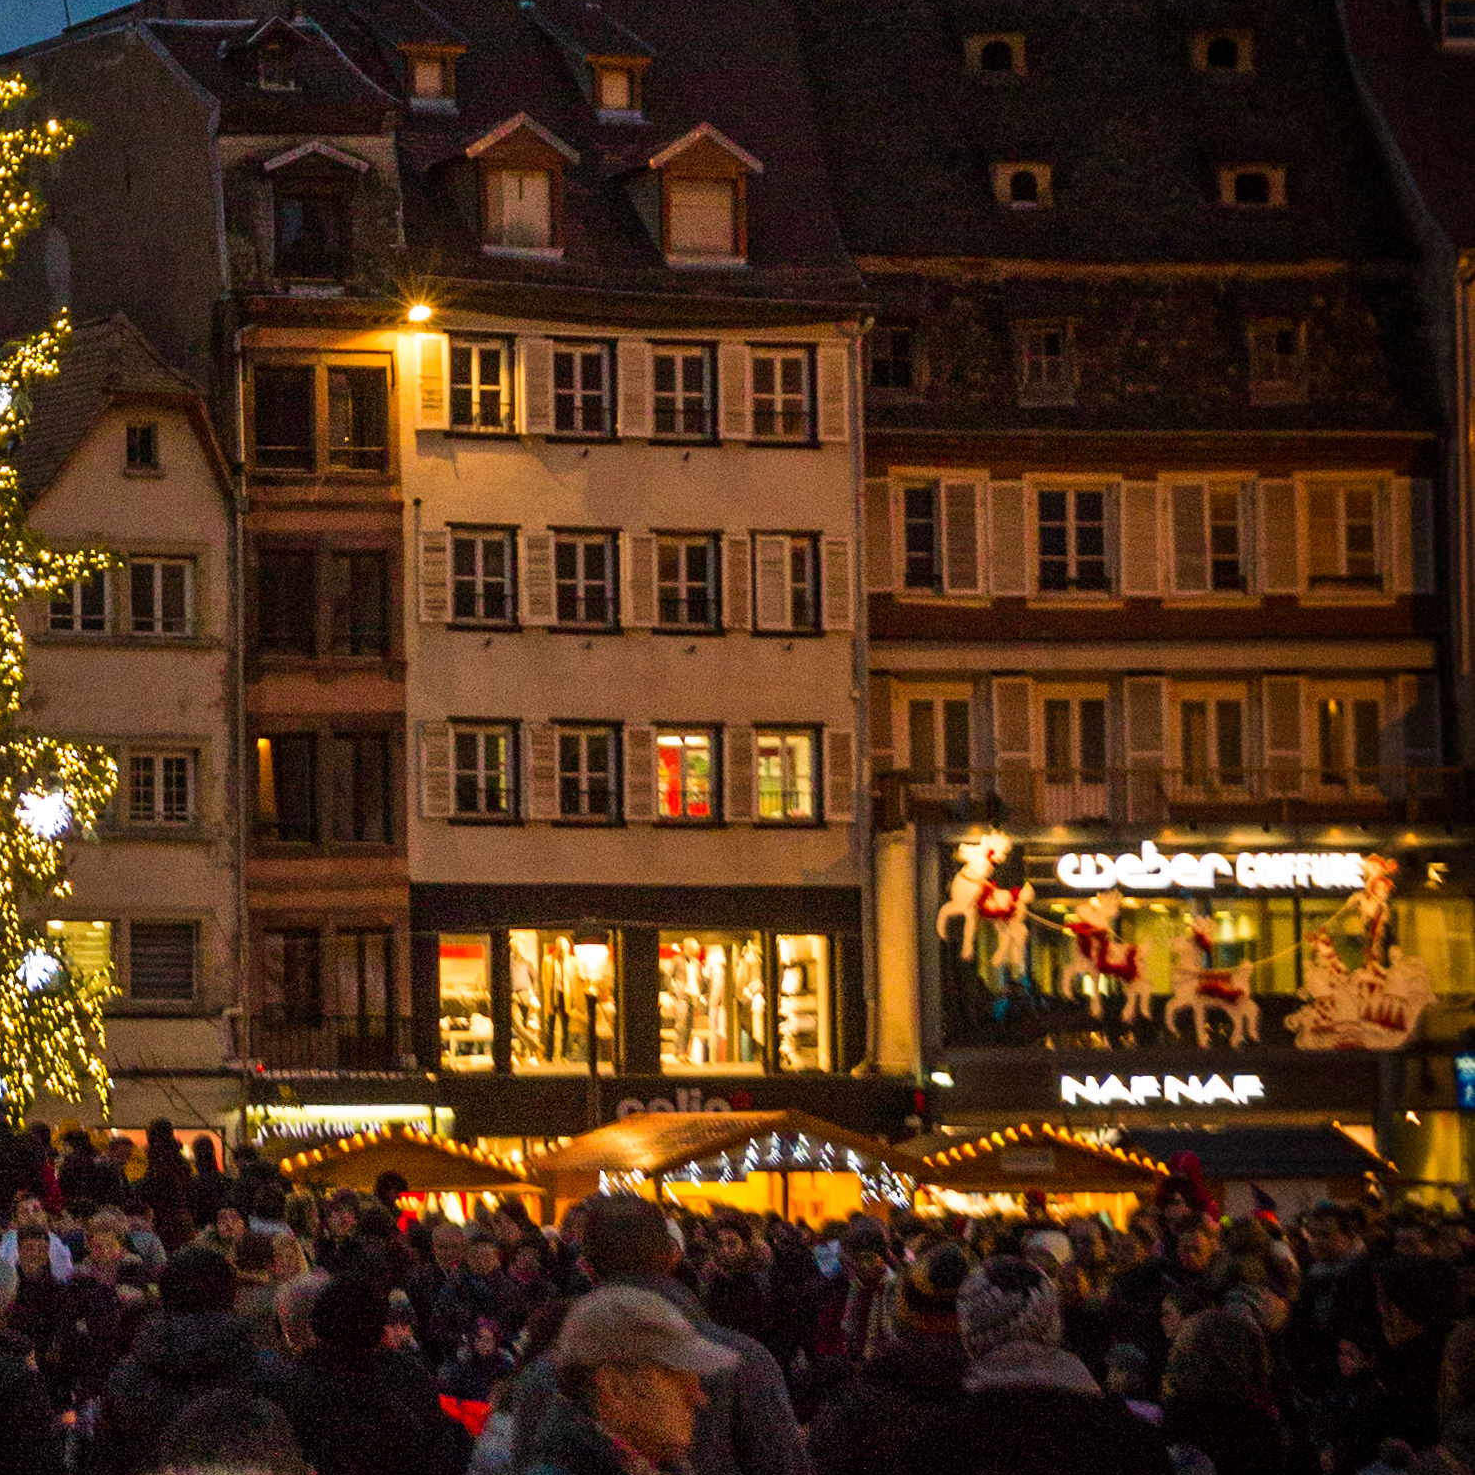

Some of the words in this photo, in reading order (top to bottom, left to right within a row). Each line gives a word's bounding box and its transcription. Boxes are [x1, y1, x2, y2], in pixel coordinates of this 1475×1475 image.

[1056, 840, 1233, 888] weber
[1236, 851, 1365, 888] COIFFURE
[1061, 1074, 1161, 1105] NAF
[1164, 1074, 1265, 1105] NAF
